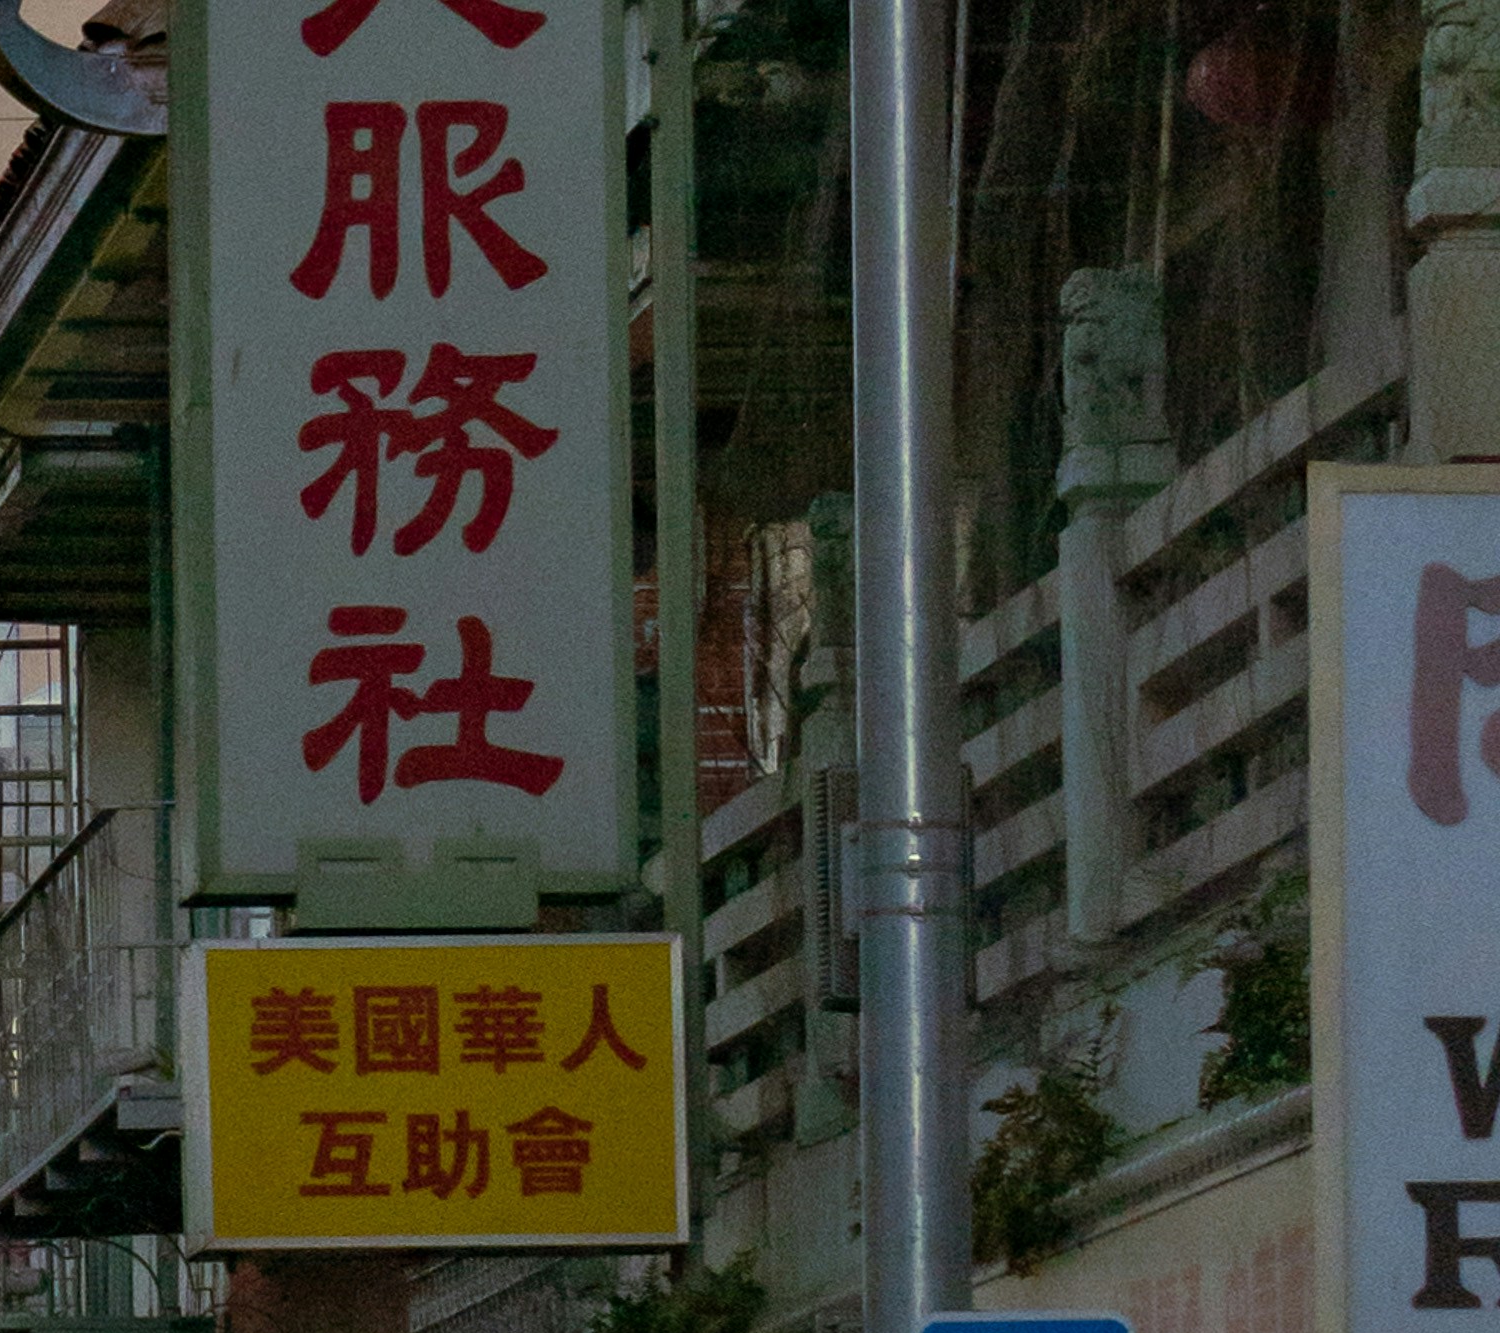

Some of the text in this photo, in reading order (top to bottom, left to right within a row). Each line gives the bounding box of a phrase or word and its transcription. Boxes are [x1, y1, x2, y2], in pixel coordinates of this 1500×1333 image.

[290, 0, 565, 805] 服務社
[250, 983, 649, 1075] 美國華人
[300, 1105, 595, 1199] 互助會
